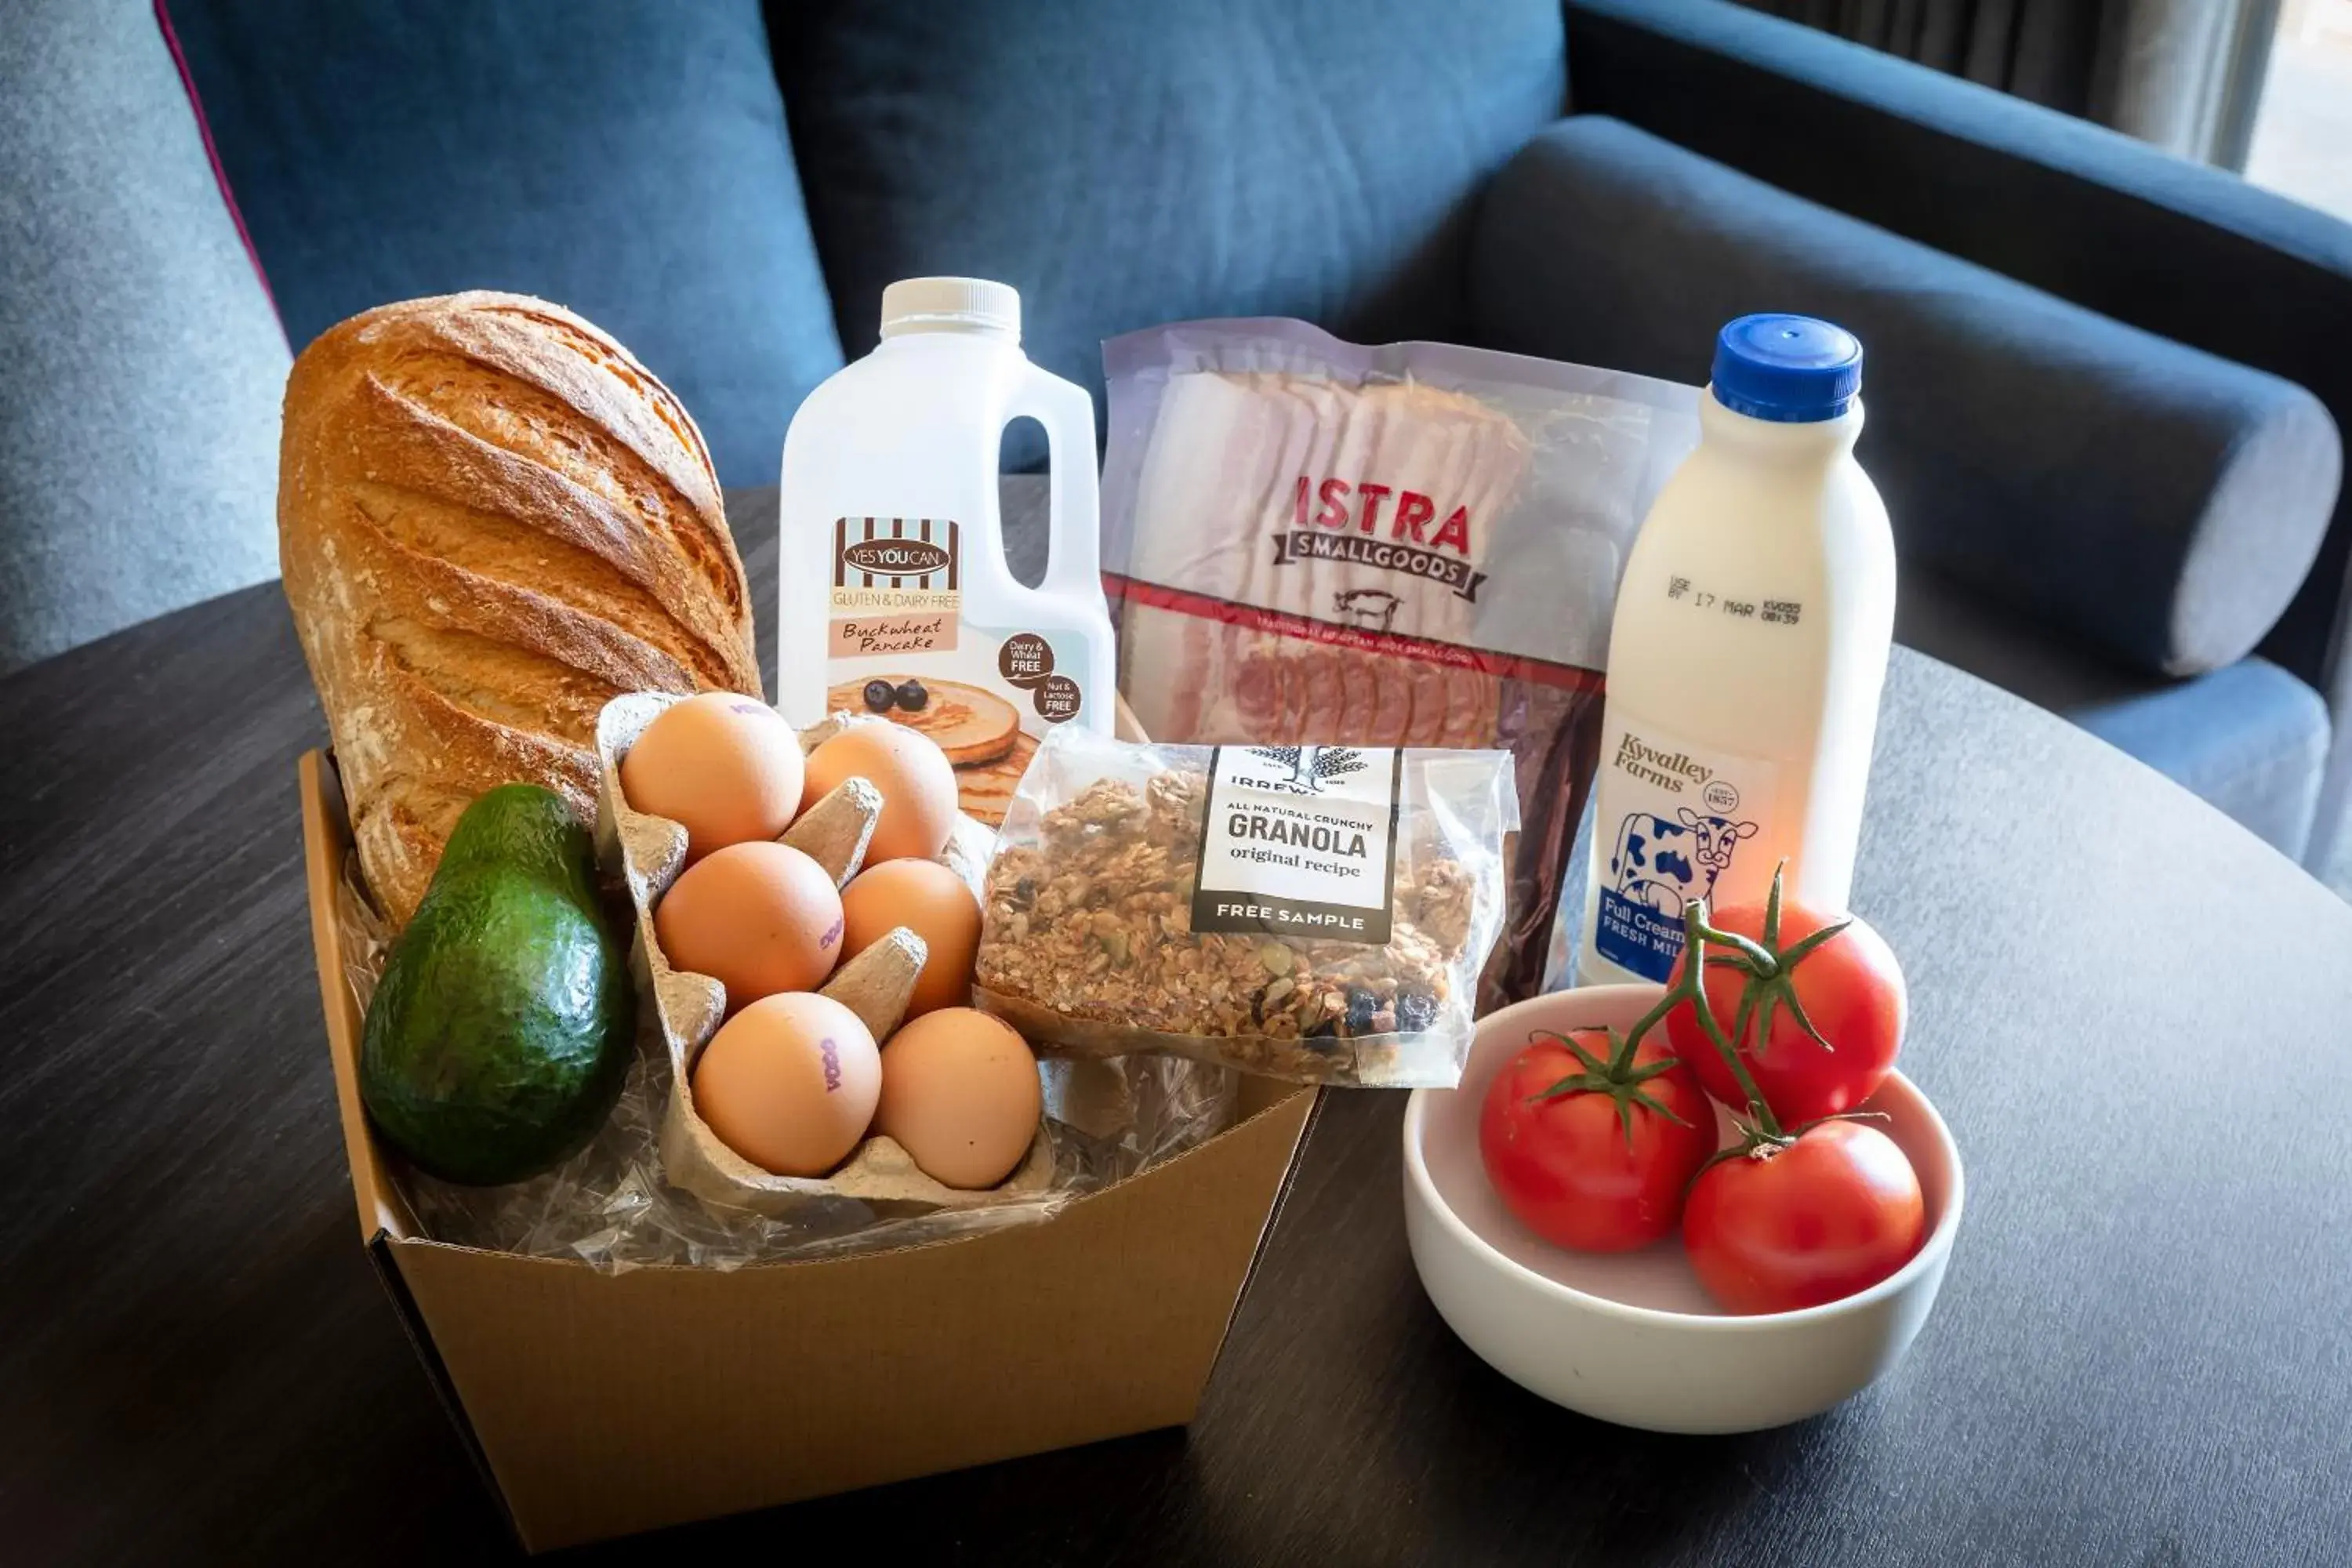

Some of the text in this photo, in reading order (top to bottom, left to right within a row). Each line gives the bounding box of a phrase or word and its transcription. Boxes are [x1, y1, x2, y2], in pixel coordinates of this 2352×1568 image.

[1293, 475, 1472, 557] ISTRA
[1298, 533, 1462, 584] SMALLGOODS
[833, 592, 960, 609] GLUTEN & DAIRY FREE
[1723, 600, 1755, 617] MAR
[843, 618, 942, 638] Buckwheat
[860, 637, 934, 652] Pancake
[1009, 641, 1044, 652] Dairy &
[1011, 650, 1041, 659] Wheat
[1011, 660, 1041, 672] FREE
[1044, 691, 1074, 700] Lactose
[1047, 682, 1062, 691] Nut
[1045, 700, 1072, 711] FREE
[1621, 732, 1713, 785] Kyvalley
[1613, 750, 1685, 793] Farms
[1227, 801, 1374, 832] ALL NATURAL CRUNCHY
[1229, 813, 1367, 858] GRANOLA
[1230, 847, 1361, 878] original recipe
[1217, 904, 1365, 930] FREE SAMPLE
[1605, 896, 1686, 943] Full Cream
[1603, 915, 1678, 957] FRESH MIL
